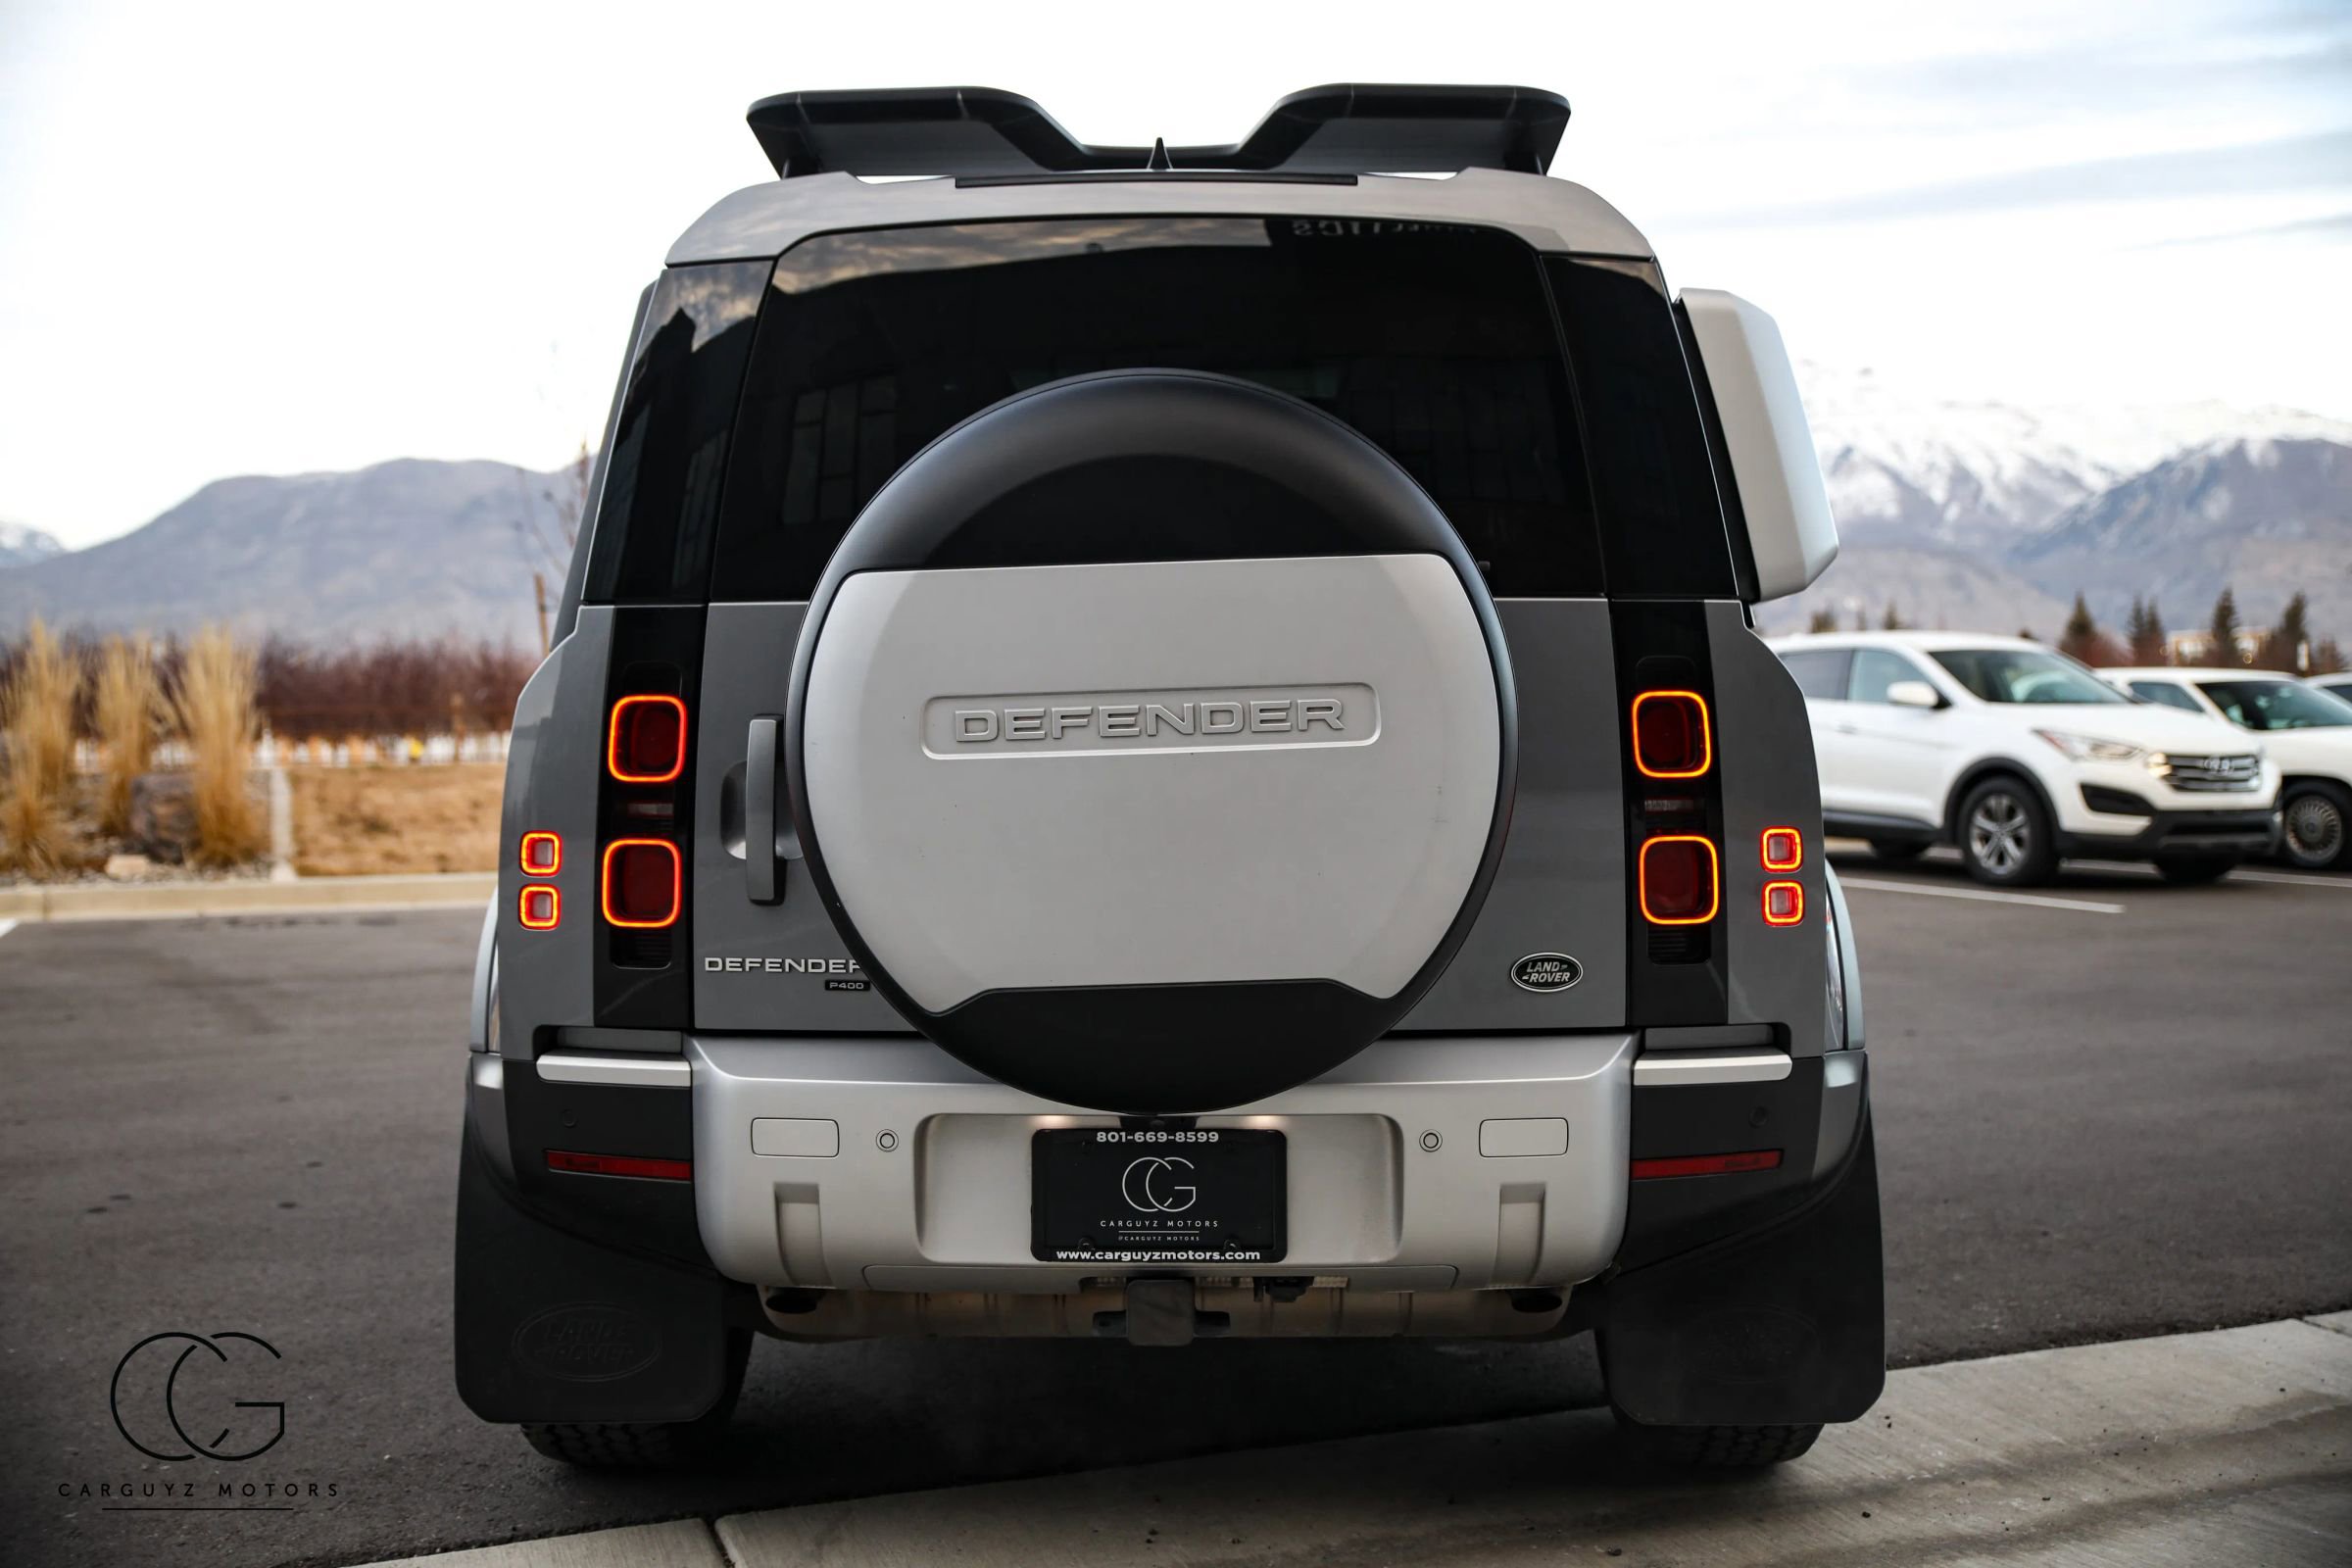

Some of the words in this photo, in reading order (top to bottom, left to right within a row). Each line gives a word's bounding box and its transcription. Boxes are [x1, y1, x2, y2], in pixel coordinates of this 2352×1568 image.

[955, 699, 1345, 742] DEFENDER
[1527, 961, 1560, 972] LAND
[1529, 972, 1571, 983] ROVER
[1096, 1131, 1219, 1143] 801-669-8599
[1056, 1250, 1260, 1261] www.carguyzmotors.com
